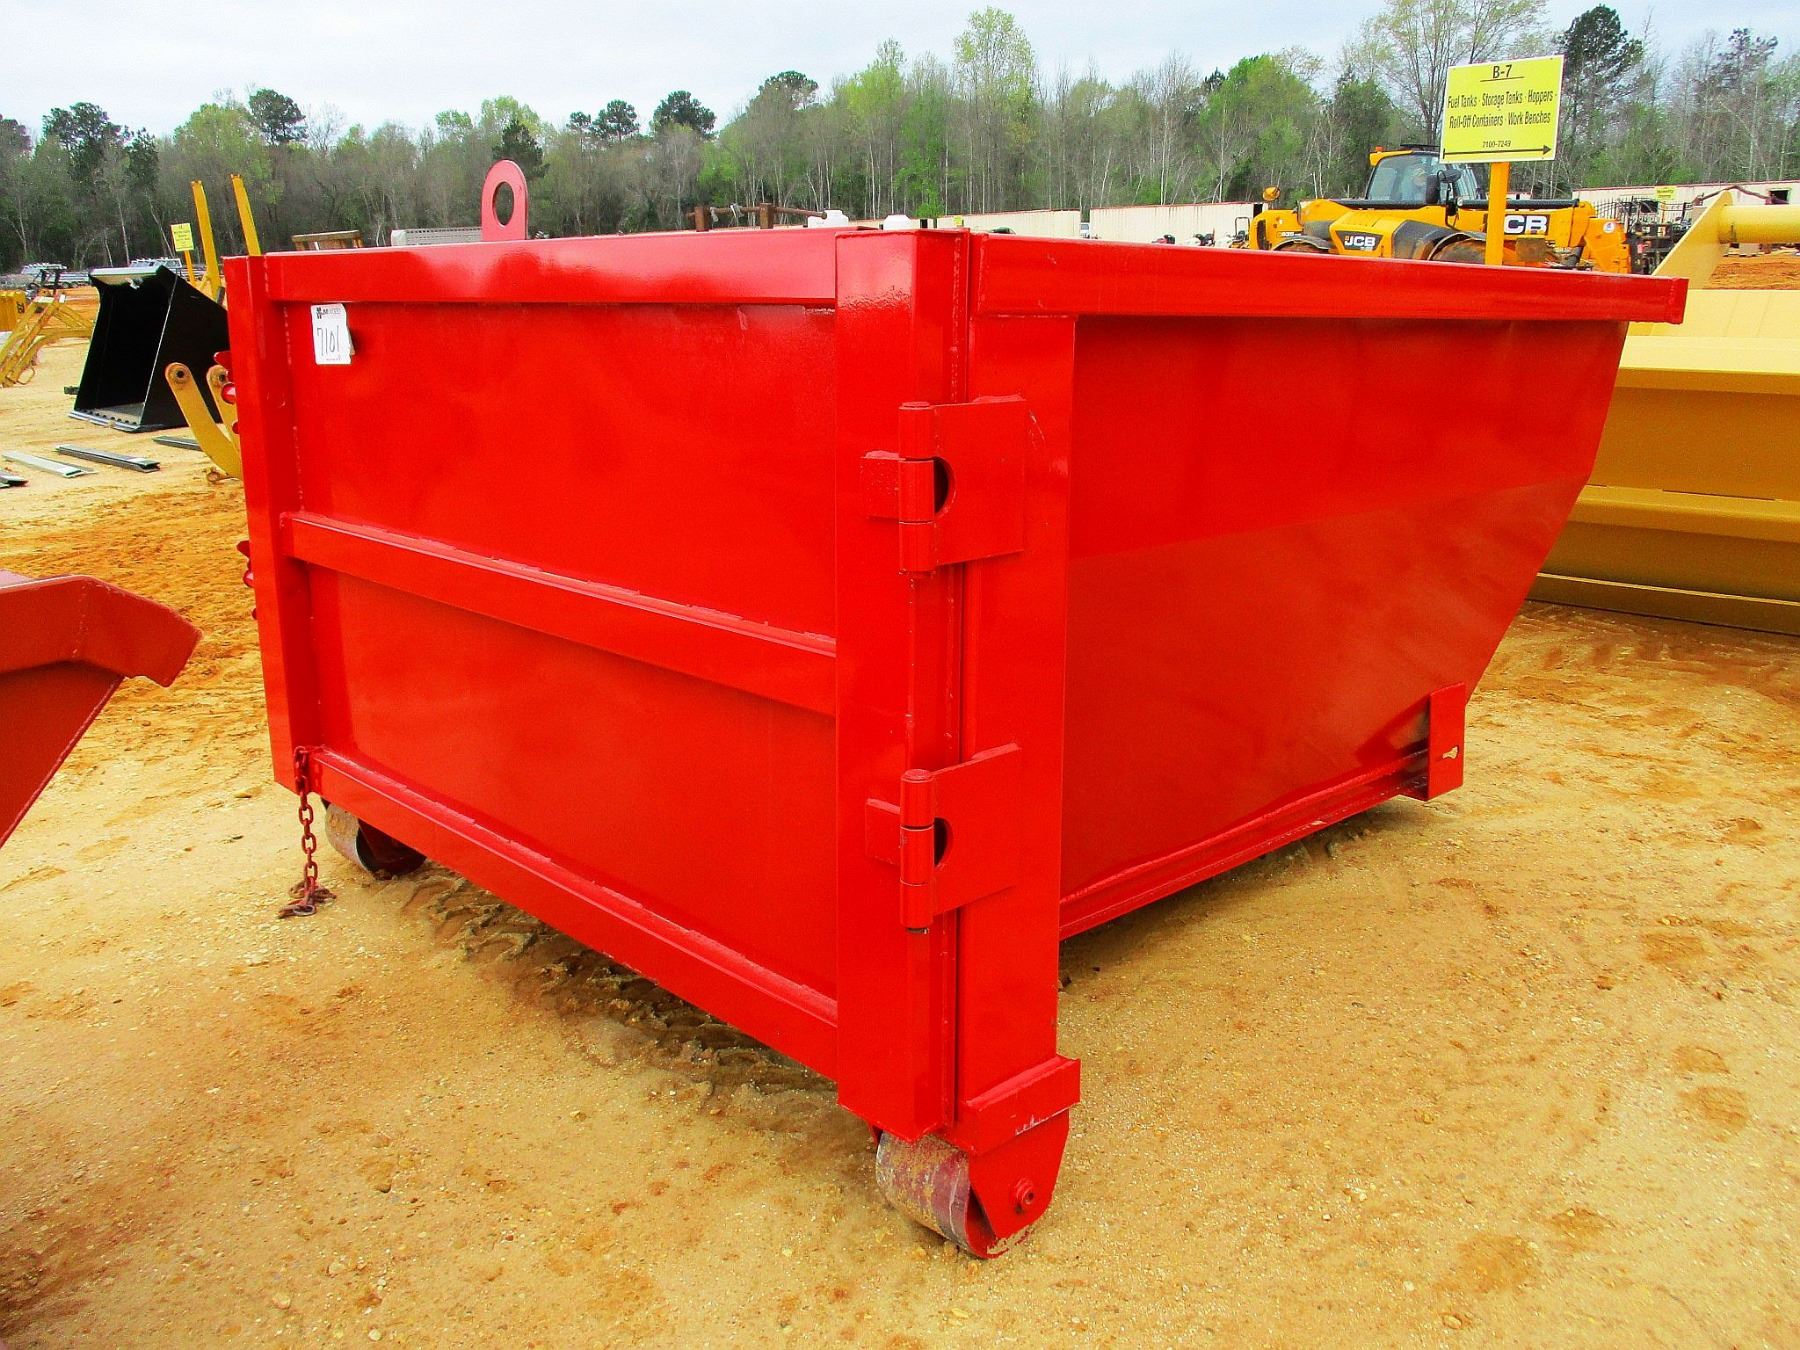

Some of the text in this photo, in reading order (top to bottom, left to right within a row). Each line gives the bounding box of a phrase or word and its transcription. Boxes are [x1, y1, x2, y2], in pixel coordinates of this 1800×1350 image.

[1492, 64, 1513, 79] B-7
[1448, 90, 1553, 108] Fuel Tanks Storage Tanks Hoppers
[1450, 111, 1551, 128] Roll-Off Containers Work Benches
[1504, 215, 1547, 233] CB
[1344, 235, 1376, 247] JCB
